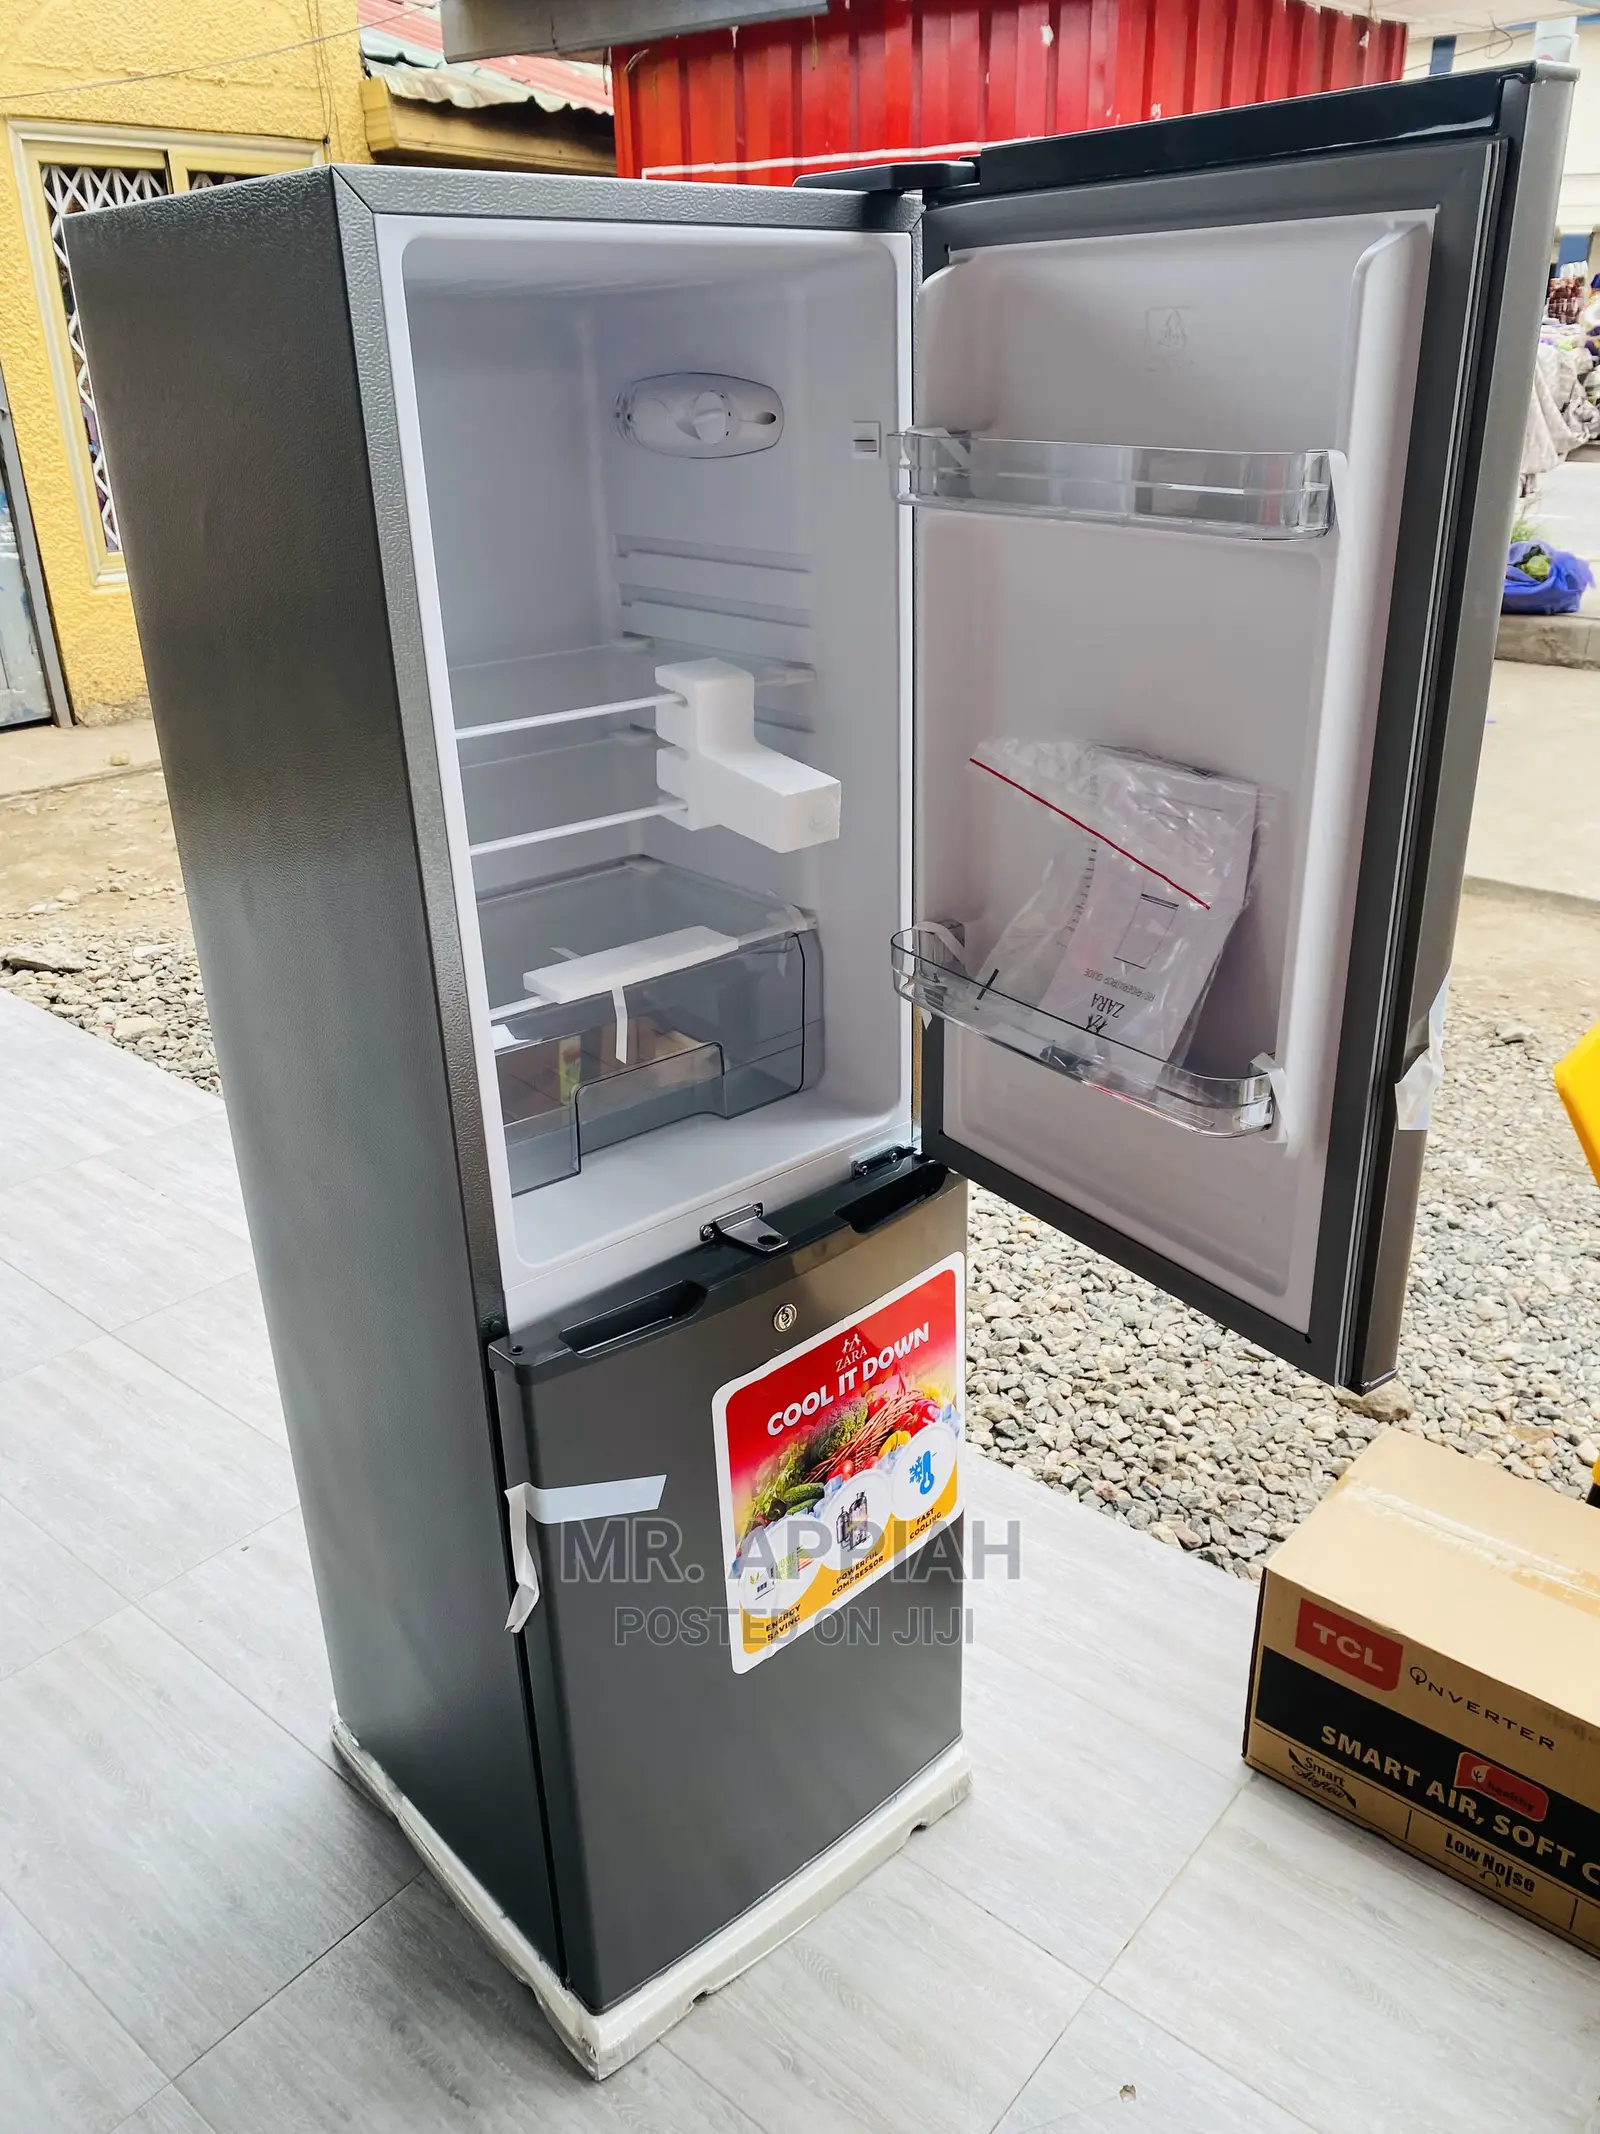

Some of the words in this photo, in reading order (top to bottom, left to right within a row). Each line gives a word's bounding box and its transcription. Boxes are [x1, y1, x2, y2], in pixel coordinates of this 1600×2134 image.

[1091, 993, 1125, 1018] ZARA
[835, 1345, 868, 1373] ZARA
[767, 1385, 834, 1436] COOL
[838, 1366, 858, 1397] IT
[862, 1322, 929, 1382] DOWN
[909, 1511, 942, 1539] COOLING
[916, 1507, 935, 1525] FAST
[831, 1555, 884, 1596] COMPRESSOR
[836, 1551, 879, 1584] POWERFUL
[765, 1604, 801, 1632] ENERGY
[767, 1615, 801, 1642] SAVING
[1312, 1621, 1384, 1672] TCL
[1304, 1756, 1346, 1788] Smart
[1321, 1725, 1421, 1787] SMART
[1426, 1780, 1485, 1825] AIR,
[1493, 1814, 1576, 1868] SOFT
